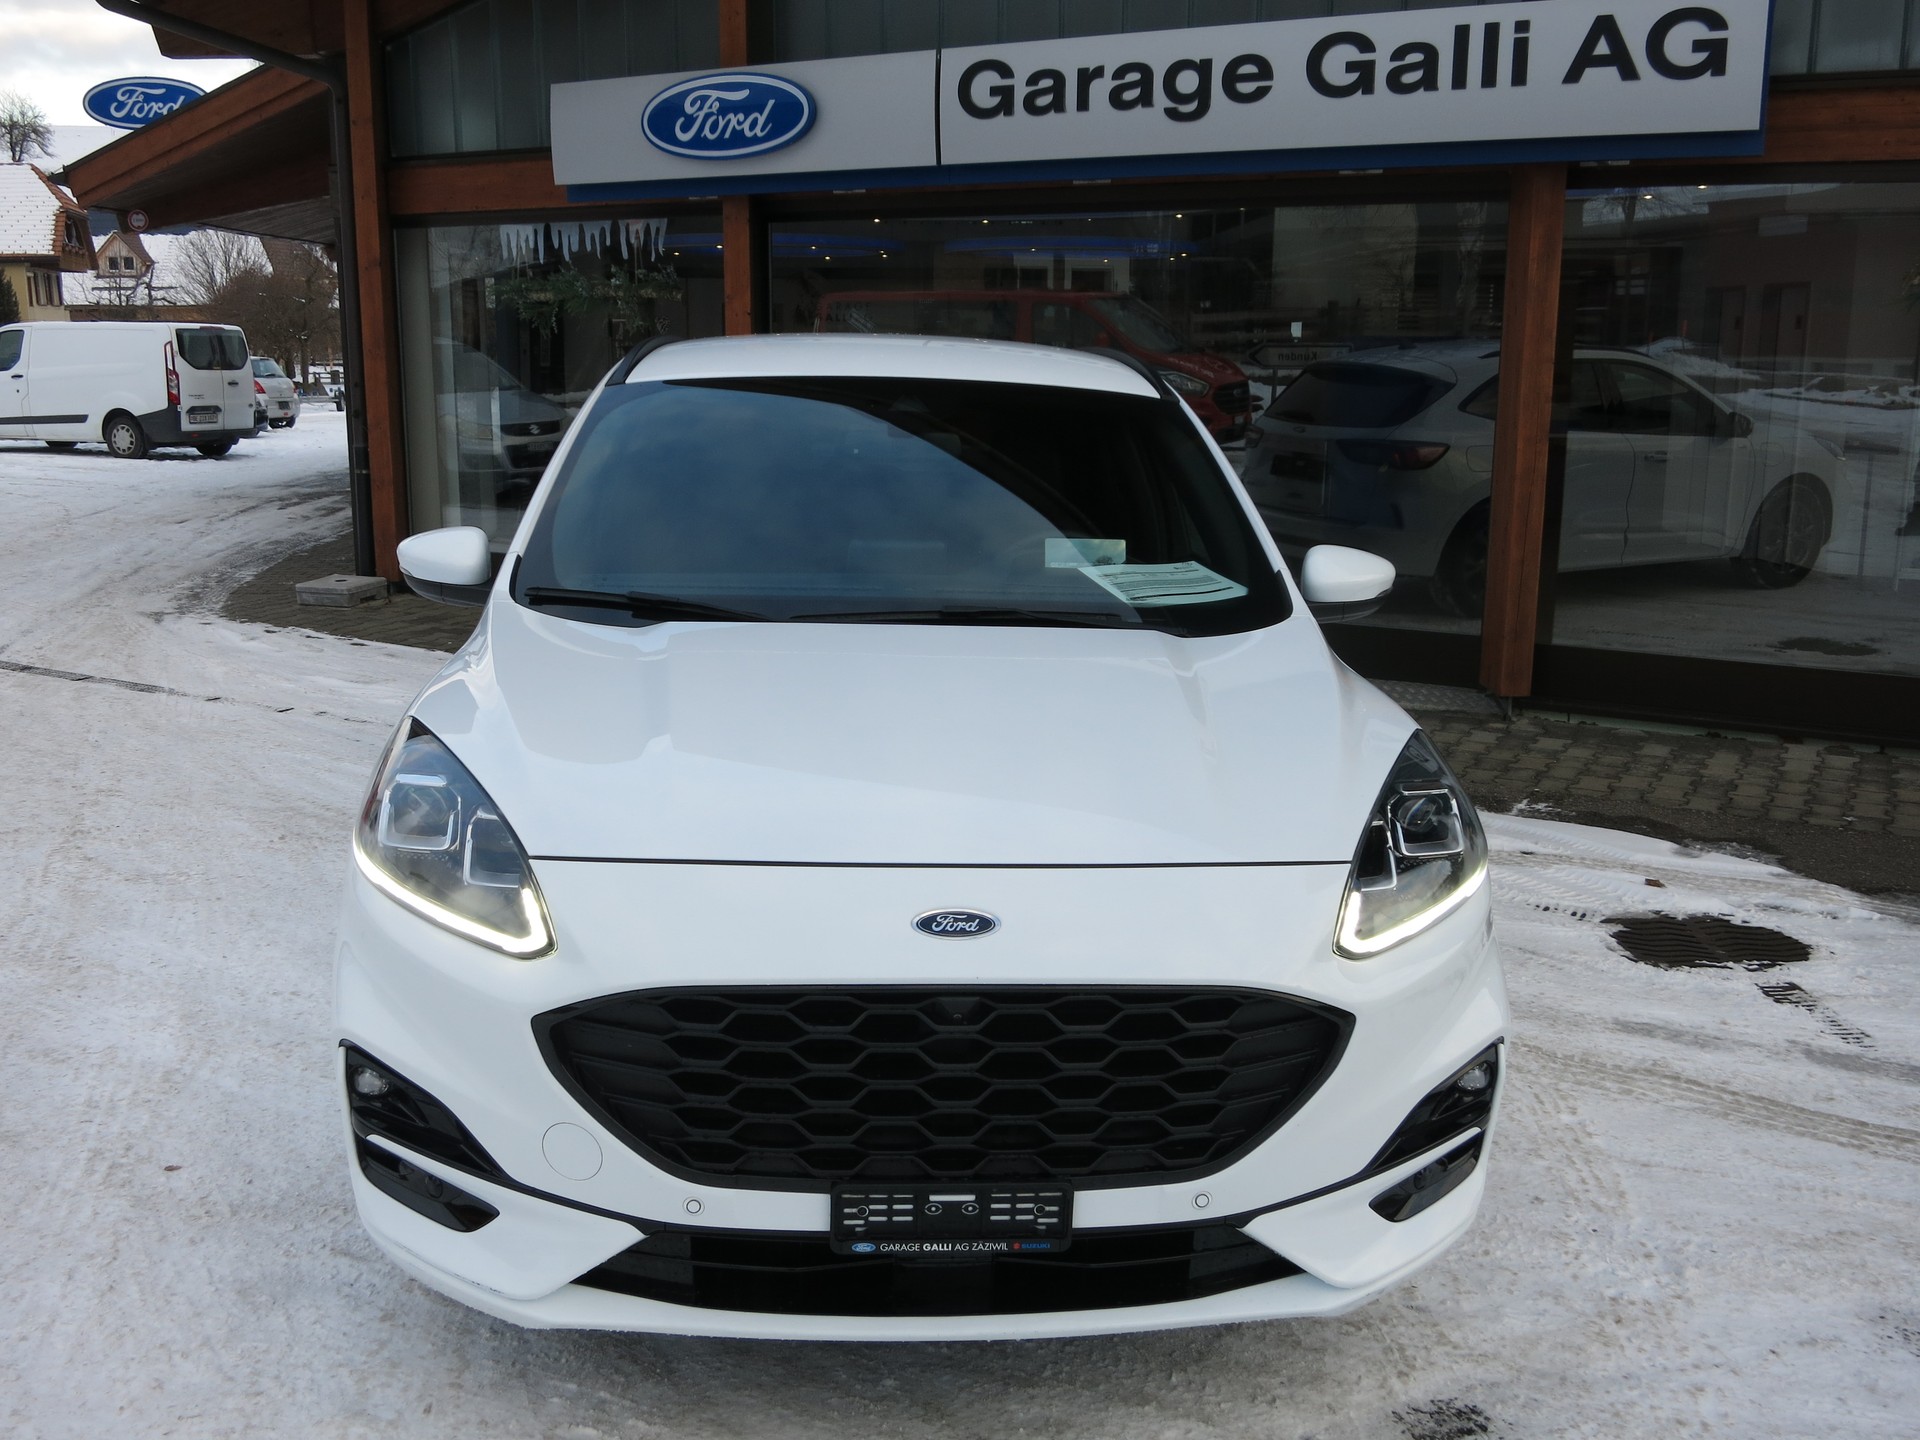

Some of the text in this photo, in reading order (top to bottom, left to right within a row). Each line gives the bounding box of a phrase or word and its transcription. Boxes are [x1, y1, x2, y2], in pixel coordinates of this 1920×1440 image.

[956, 6, 1729, 123] Garage Galli AG
[674, 88, 776, 142] Ford
[931, 914, 980, 932] Ford
[880, 1243, 921, 1252] GARAGE
[923, 1243, 952, 1251] GALLI
[954, 1242, 969, 1251] AG
